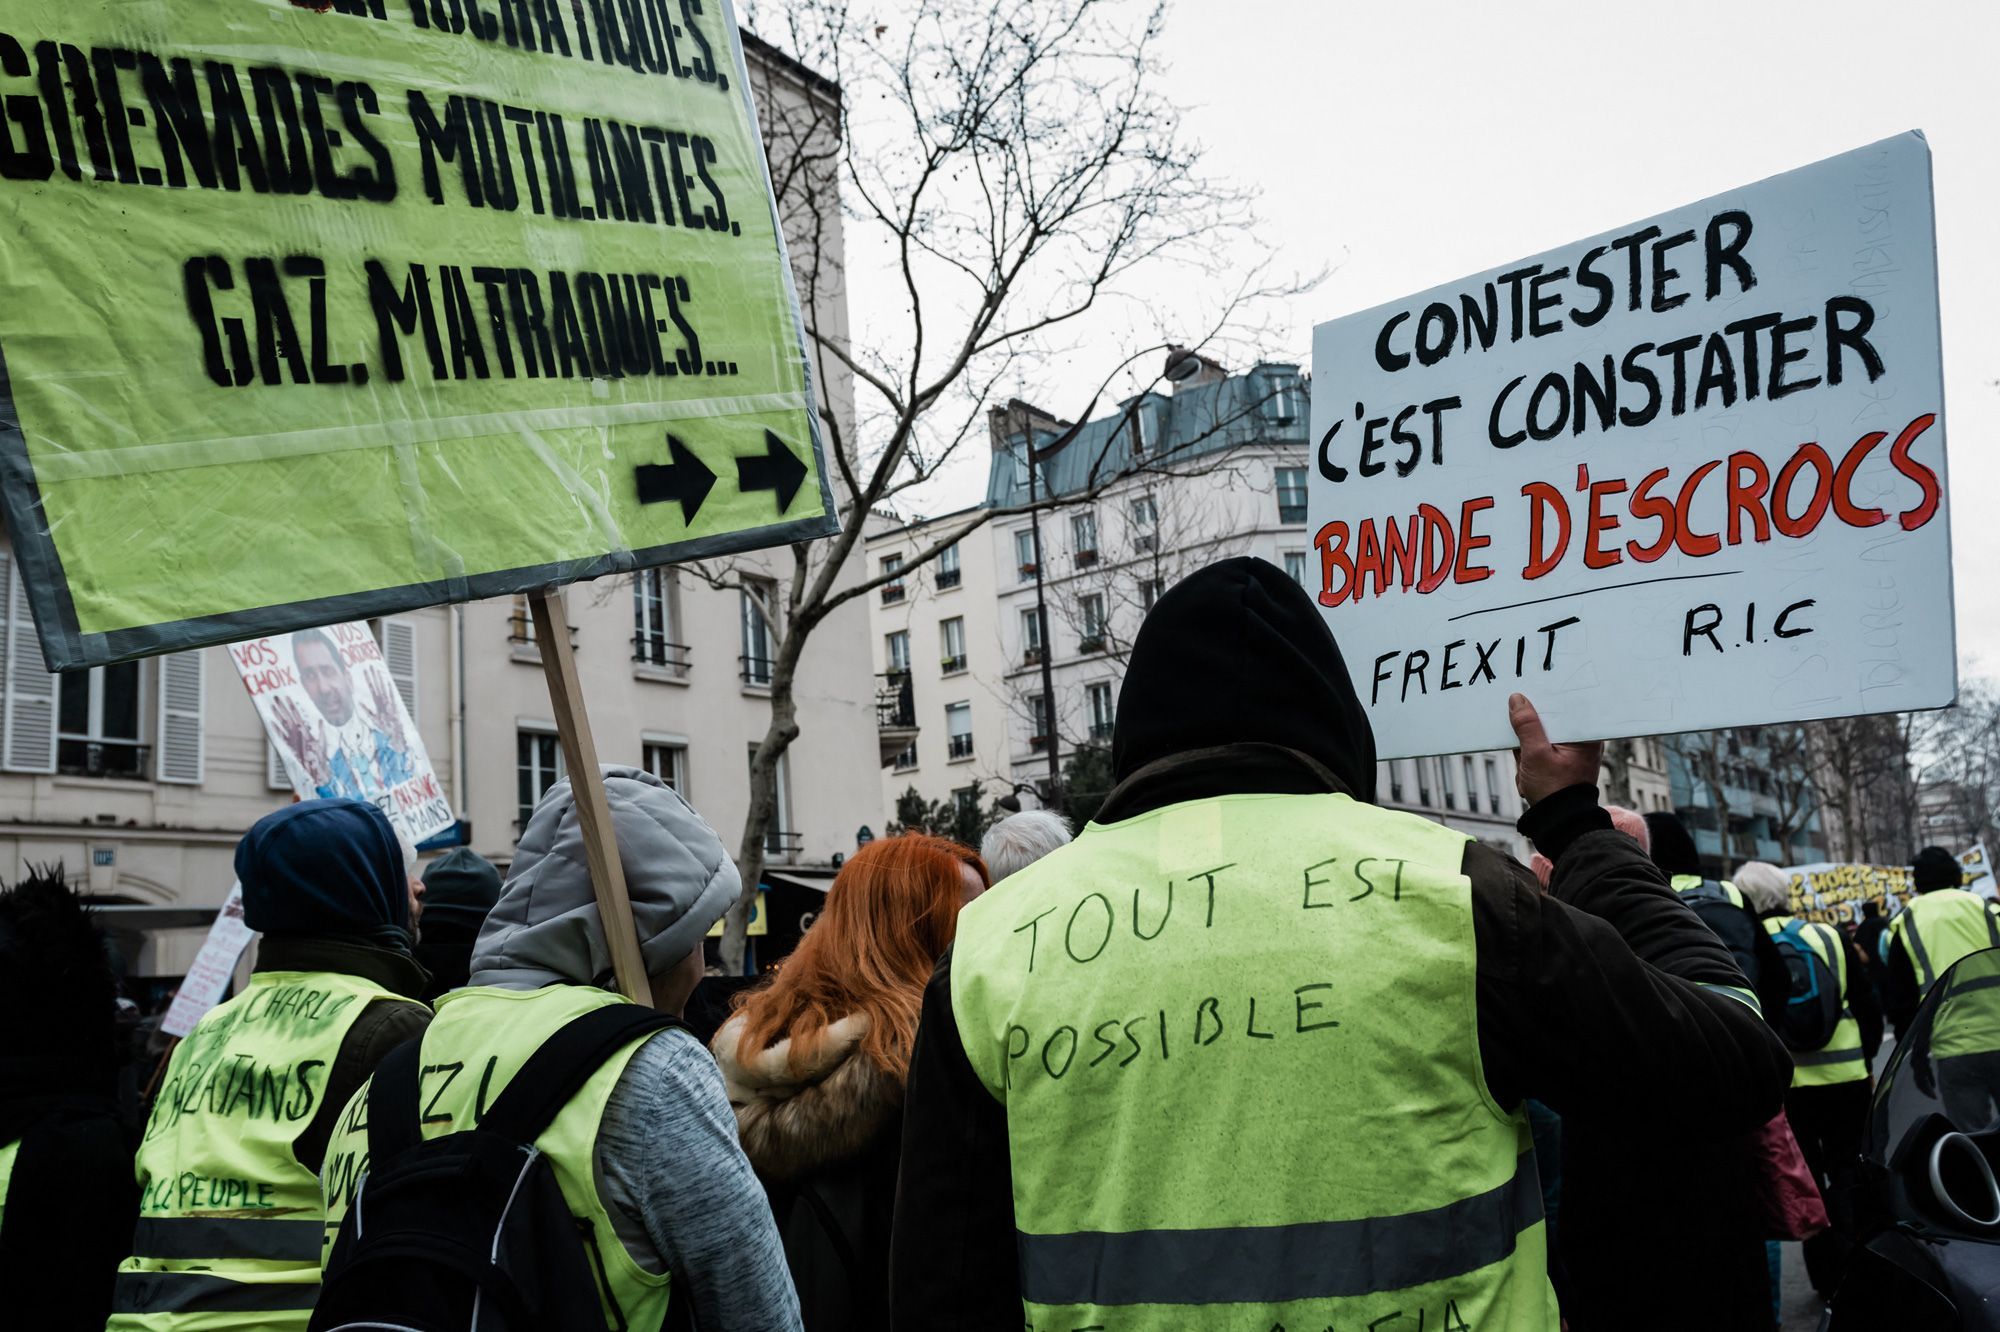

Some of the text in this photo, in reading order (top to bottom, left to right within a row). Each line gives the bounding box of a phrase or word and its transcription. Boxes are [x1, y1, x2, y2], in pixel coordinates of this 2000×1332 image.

[0, 33, 741, 236] GRENADES MUTILANTES.
[1375, 211, 1757, 372] CONTESTER
[1318, 402, 1462, 482] C'EST
[1488, 296, 1885, 449] CONSTATER
[1313, 497, 1495, 607] BANDE
[1521, 413, 1942, 580] D'ESCROCS
[233, 638, 280, 669] VOS
[243, 665, 298, 697] CHOIX
[1372, 616, 1580, 707] FREXIT
[406, 799, 450, 837] MAINS
[1013, 857, 1413, 974] TOUT EST
[1007, 983, 1341, 1090] POSSIBLE
[178, 1171, 274, 1210] PEUPLE
